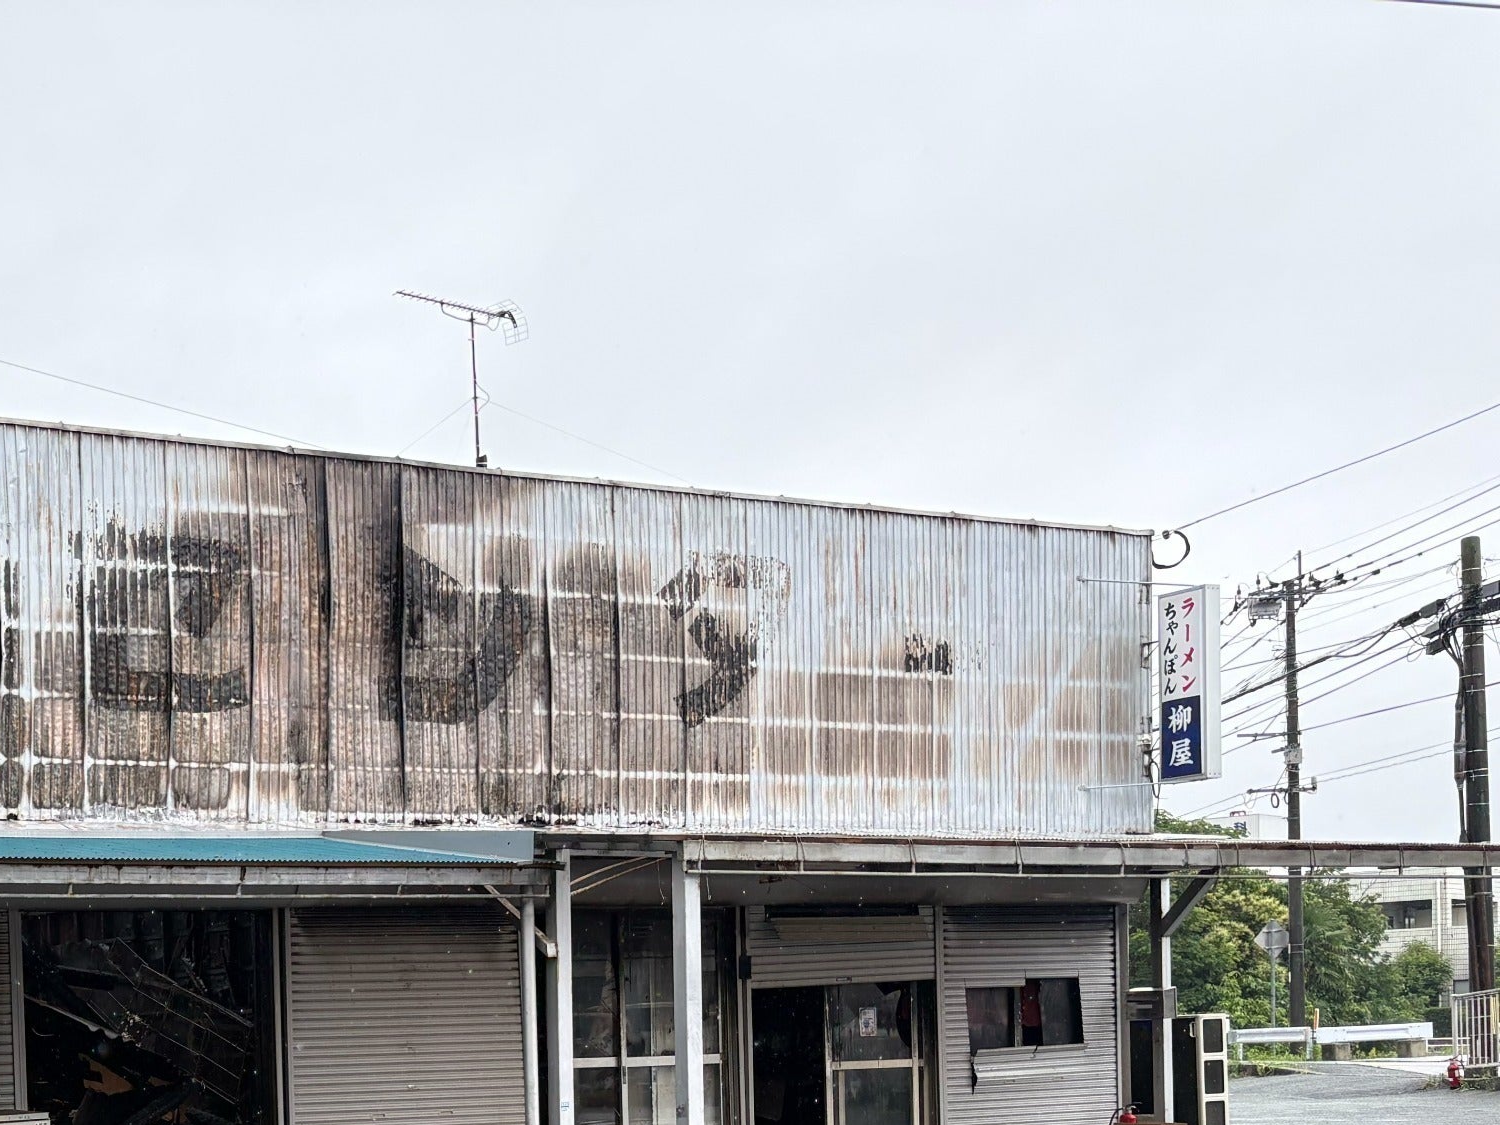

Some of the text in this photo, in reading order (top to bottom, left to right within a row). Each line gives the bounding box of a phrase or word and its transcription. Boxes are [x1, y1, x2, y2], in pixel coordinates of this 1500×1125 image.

[1163, 602, 1179, 696] ちゃんぽん
[1180, 597, 1196, 693] ラーメン
[1167, 704, 1194, 768] 柳屋
